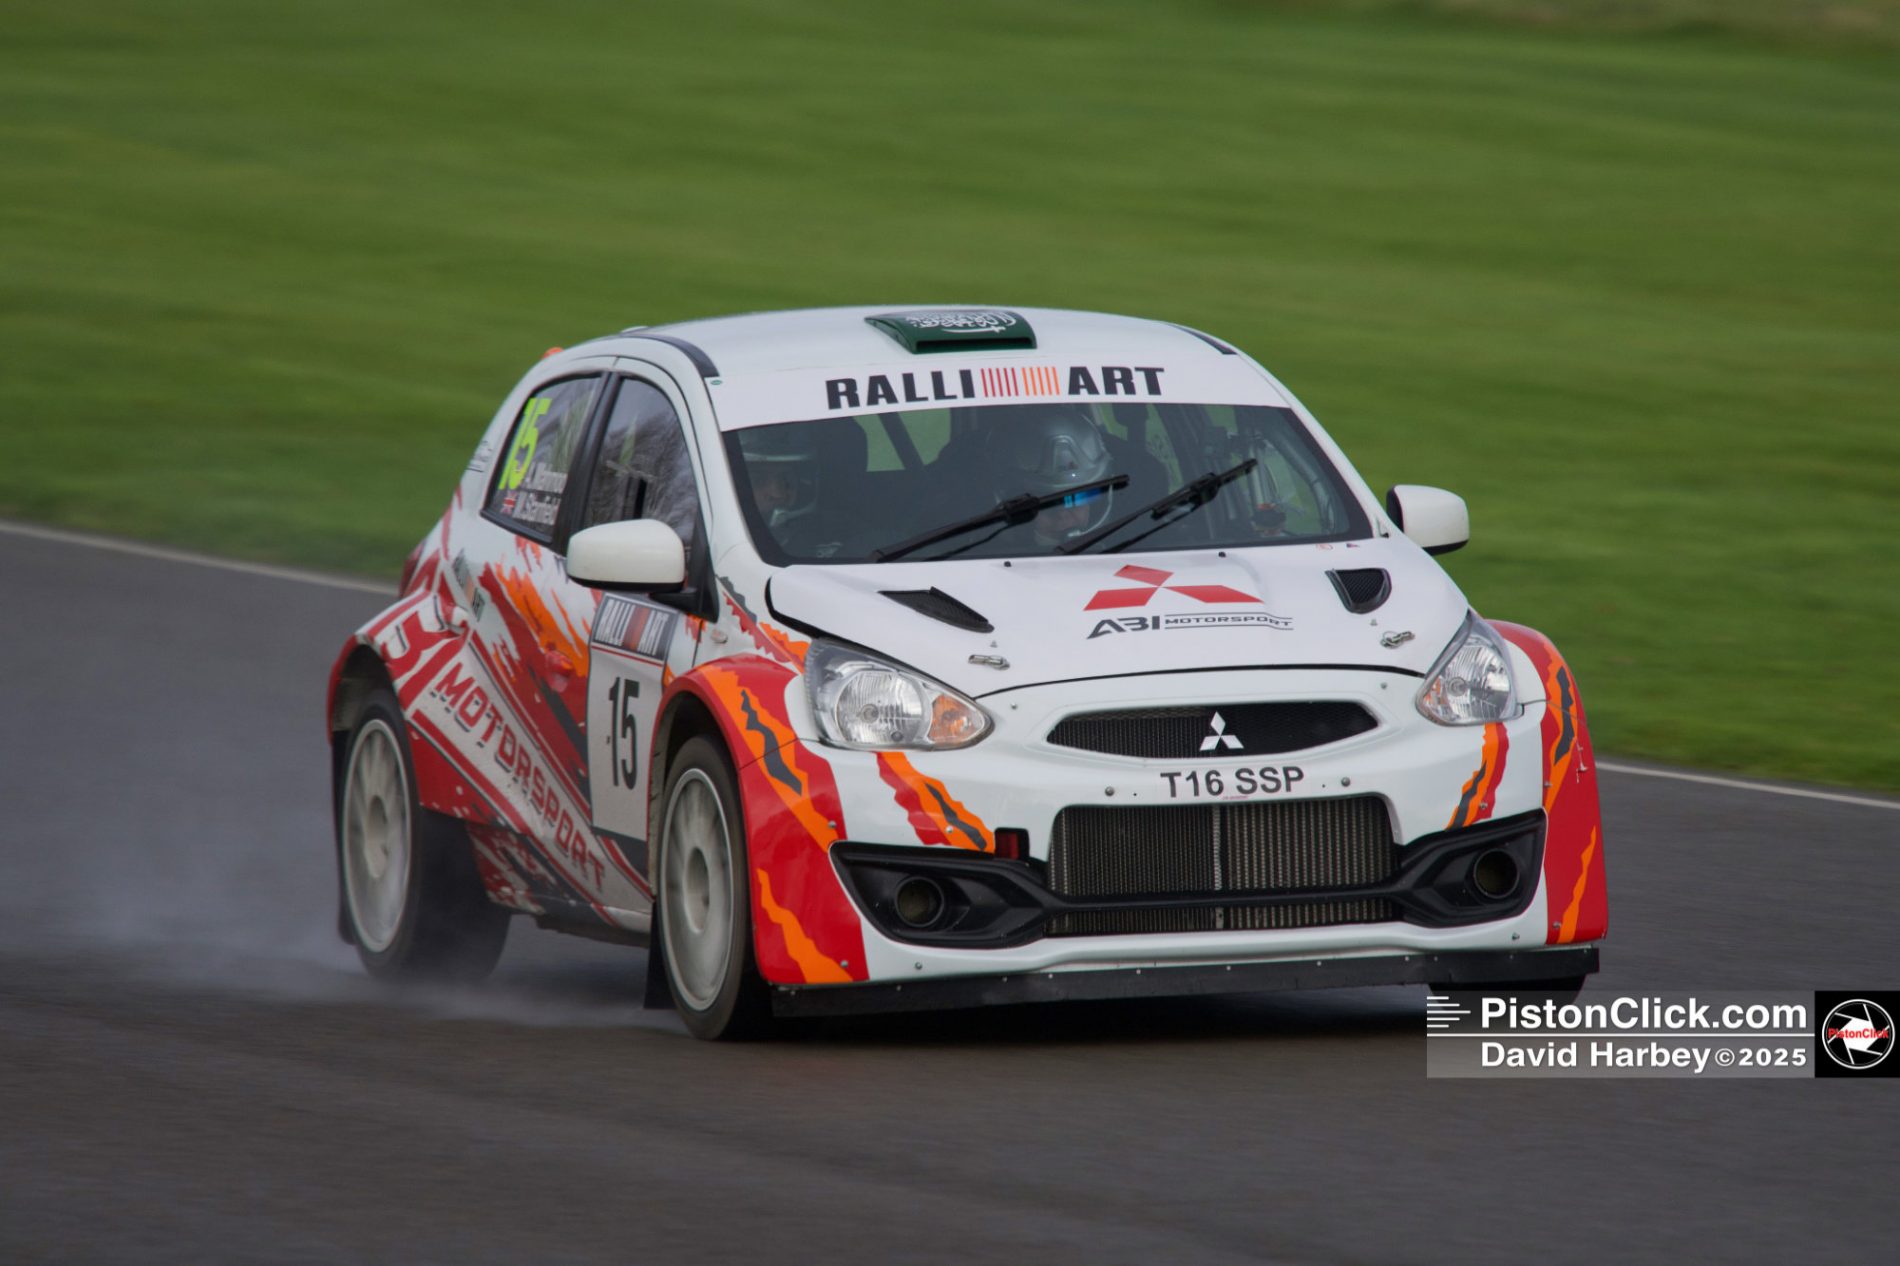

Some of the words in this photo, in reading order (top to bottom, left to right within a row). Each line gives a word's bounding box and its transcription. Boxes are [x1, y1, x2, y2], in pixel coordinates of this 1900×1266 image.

[825, 369, 976, 410] RALLI
[1068, 366, 1165, 396] ART
[498, 397, 552, 490] 15
[1086, 616, 1160, 640] ABI
[1165, 615, 1292, 627] MOTORSPORT
[609, 676, 640, 790] 15
[432, 661, 606, 893] MOTORSPORT
[1160, 770, 1224, 798] T16
[1235, 766, 1304, 795] SSP
